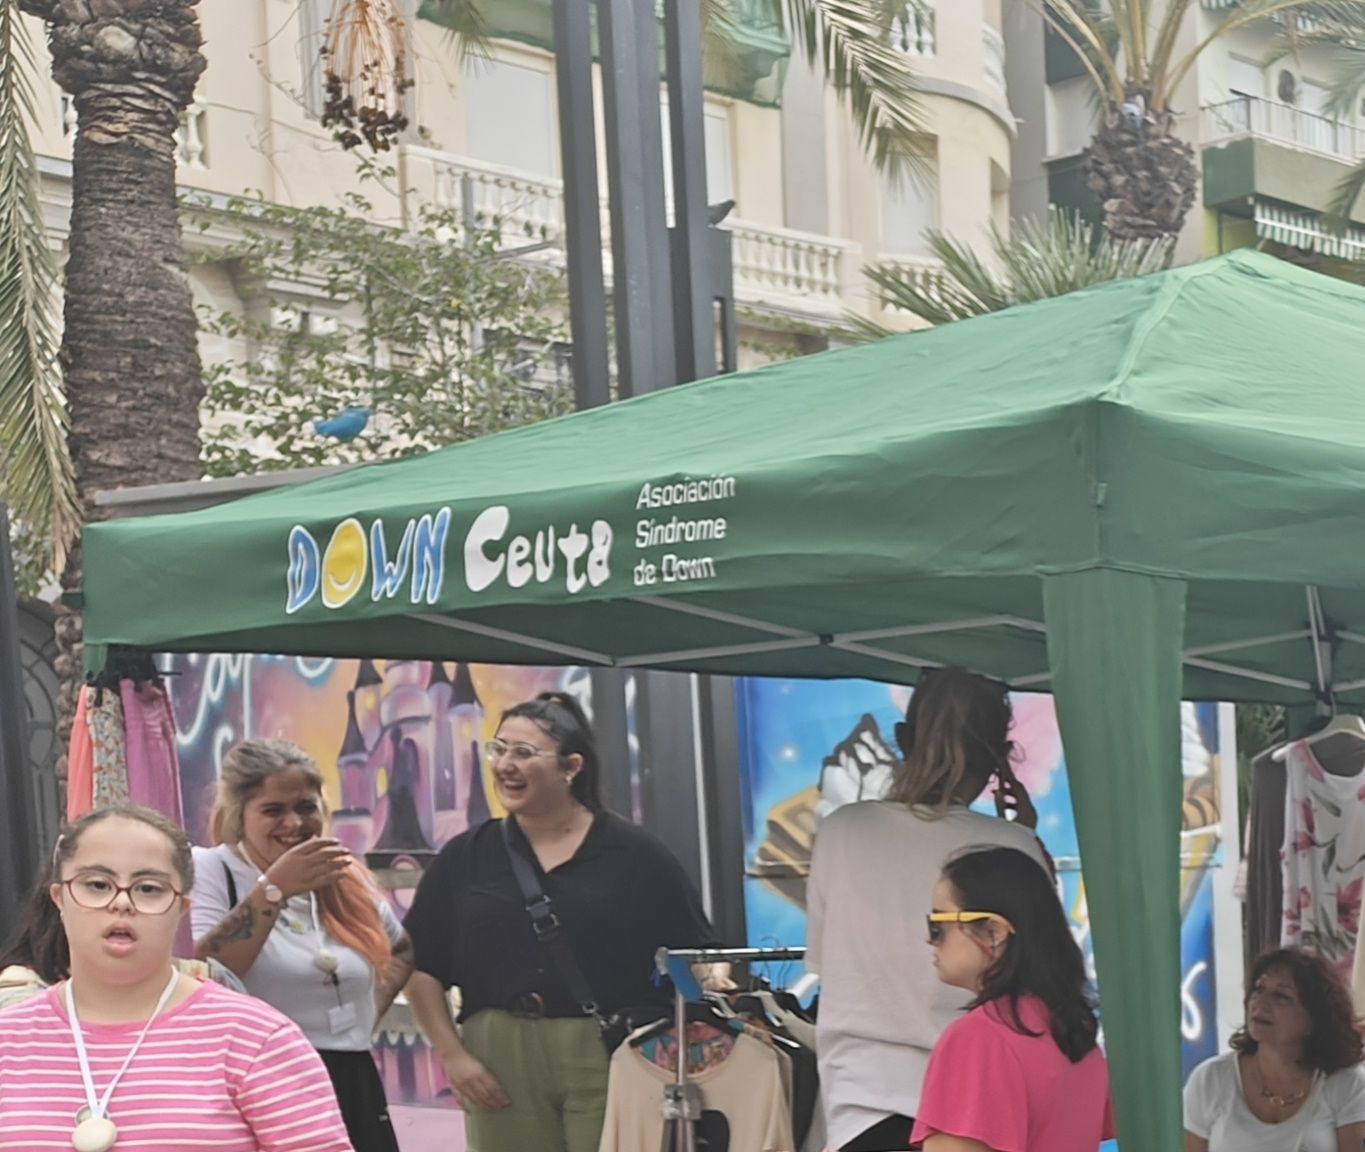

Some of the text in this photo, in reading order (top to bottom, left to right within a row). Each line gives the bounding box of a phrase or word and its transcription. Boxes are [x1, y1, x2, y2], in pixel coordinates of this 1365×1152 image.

[636, 473, 735, 510] Asociación
[635, 515, 727, 548] Síndrome
[286, 505, 613, 614] DOWN Ceuta
[633, 553, 716, 586] de Down
